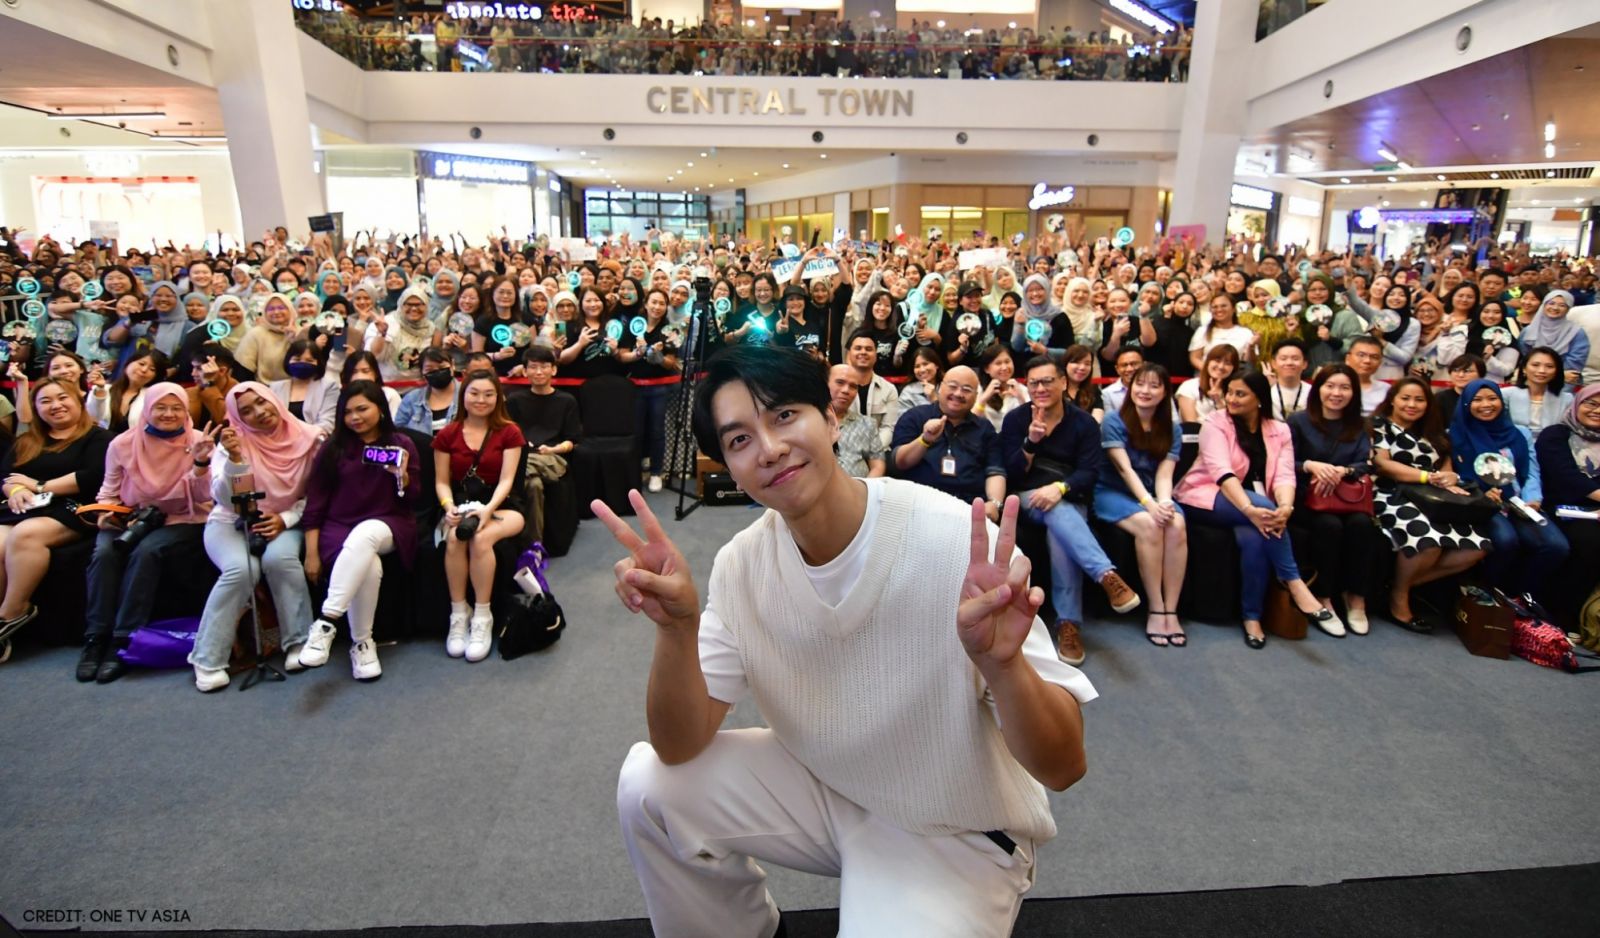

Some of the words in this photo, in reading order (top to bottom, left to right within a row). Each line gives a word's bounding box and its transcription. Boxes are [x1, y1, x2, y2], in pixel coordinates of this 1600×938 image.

[446, 2, 542, 19] absolute
[646, 86, 807, 116] CENTRAL
[817, 88, 914, 117] TOWN
